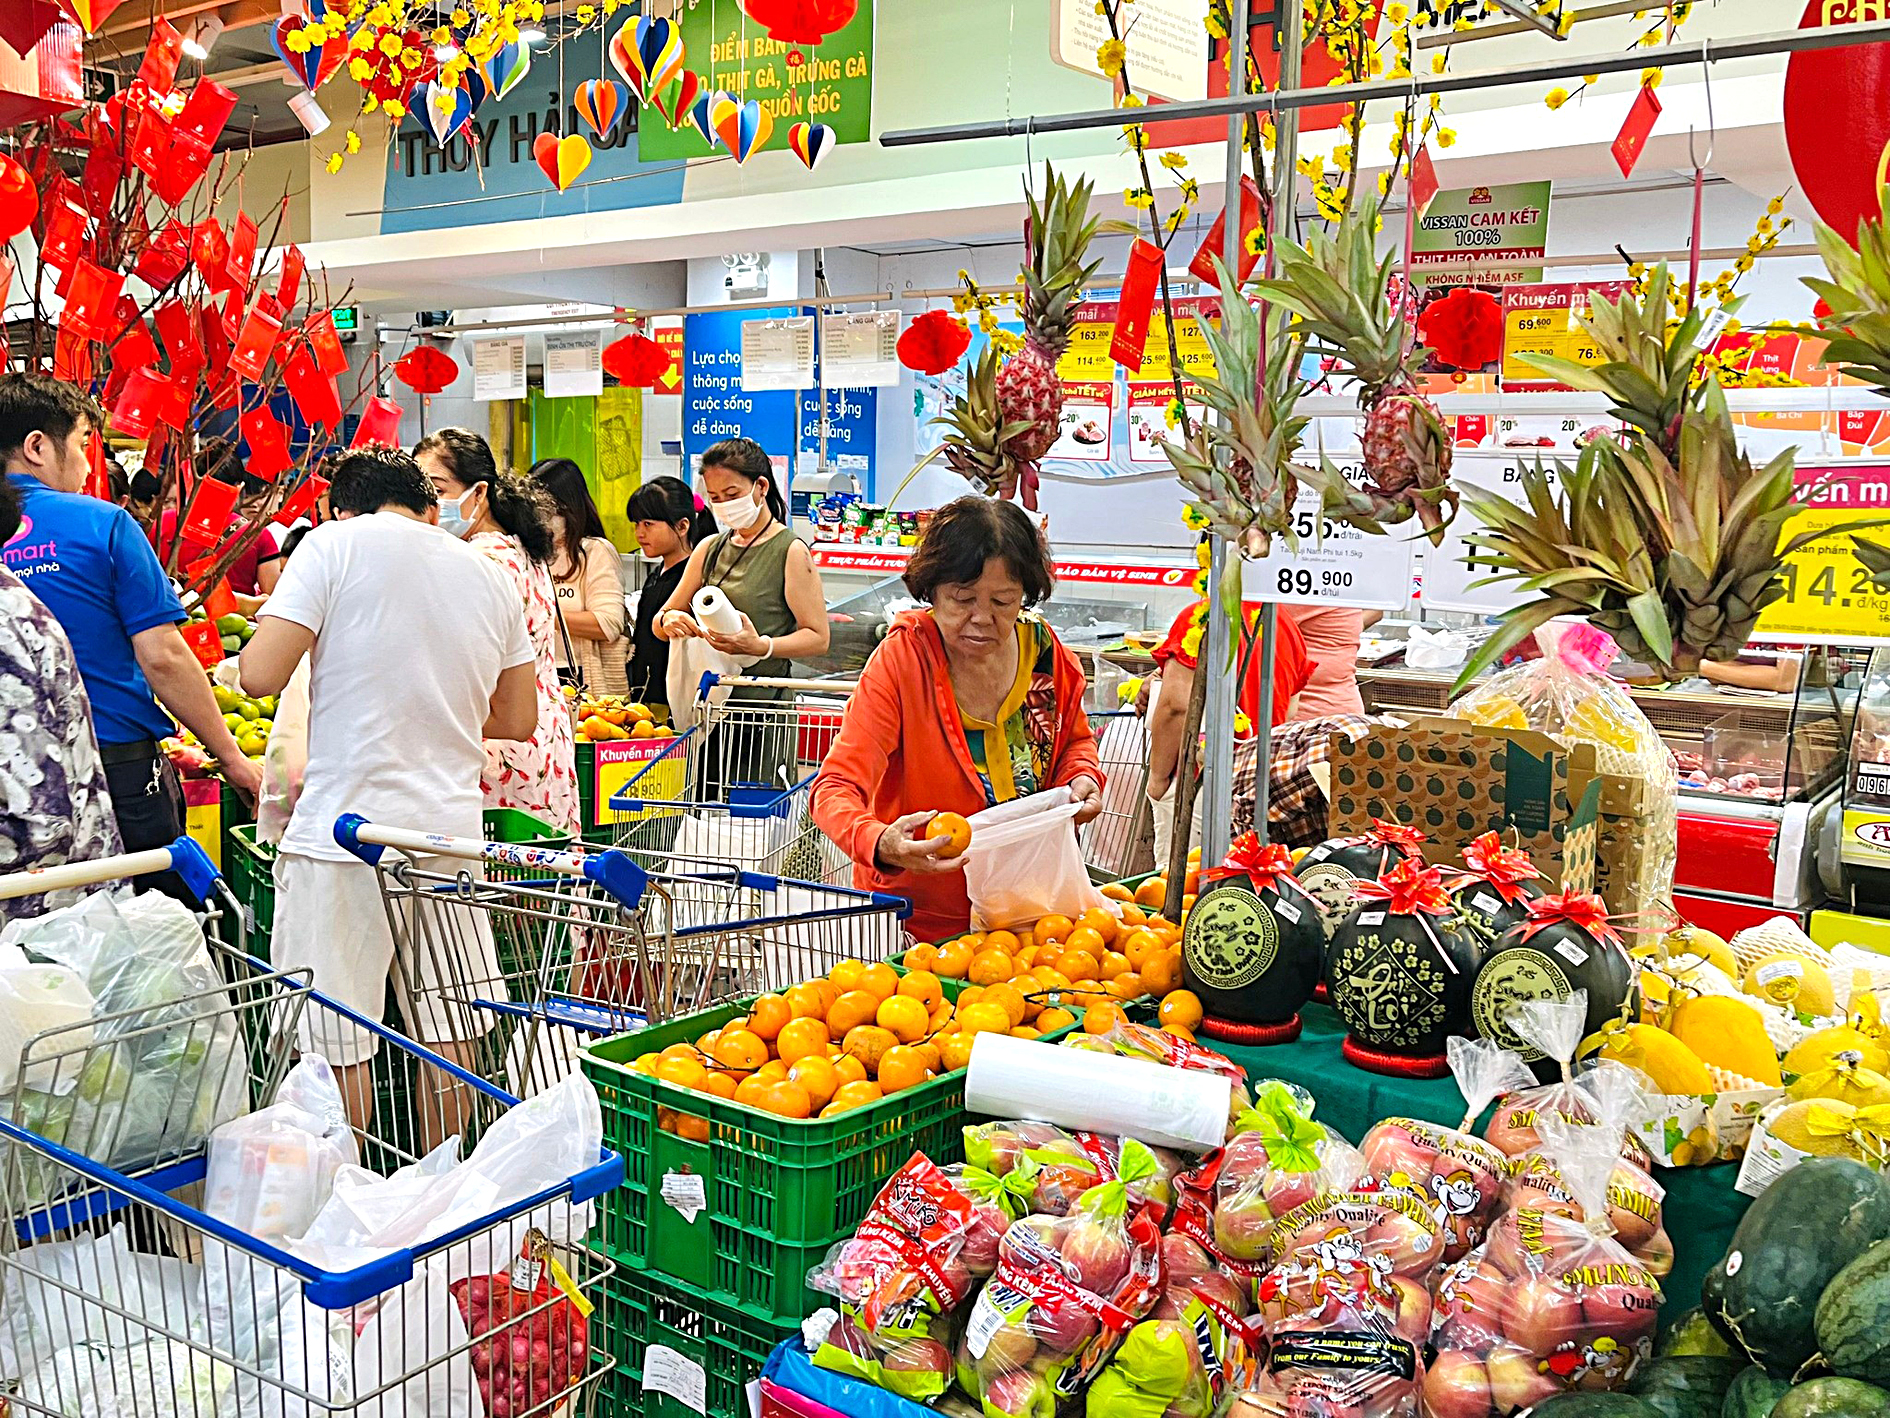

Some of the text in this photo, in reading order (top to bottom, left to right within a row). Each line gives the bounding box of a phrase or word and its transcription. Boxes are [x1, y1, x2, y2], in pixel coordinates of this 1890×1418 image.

[755, 63, 781, 90] GÀ,
[845, 51, 867, 77] GÀ
[807, 84, 841, 114] GỐC
[1421, 205, 1540, 230] VISSAN CAM KẾT
[1454, 228, 1501, 247] 100%
[1425, 273, 1468, 285] KHÔNG
[1503, 272, 1524, 282] ASF
[1507, 289, 1567, 308] Khuyến
[692, 351, 715, 369] Lựa
[718, 350, 741, 369] chọ
[692, 375, 733, 391] thông
[692, 393, 753, 414] cuộc sống
[692, 418, 741, 439] dễ dàng
[35, 562, 60, 573] nhà
[1127, 572, 1159, 580] SINH
[1277, 567, 1353, 595] 89.900
[1857, 597, 1889, 610] đ/kg
[600, 745, 642, 762] Khuyến
[1217, 1306, 1244, 1333] KÈM
[1294, 1353, 1308, 1361] our
[1310, 1353, 1341, 1363] Family
[1342, 1354, 1352, 1362] to
